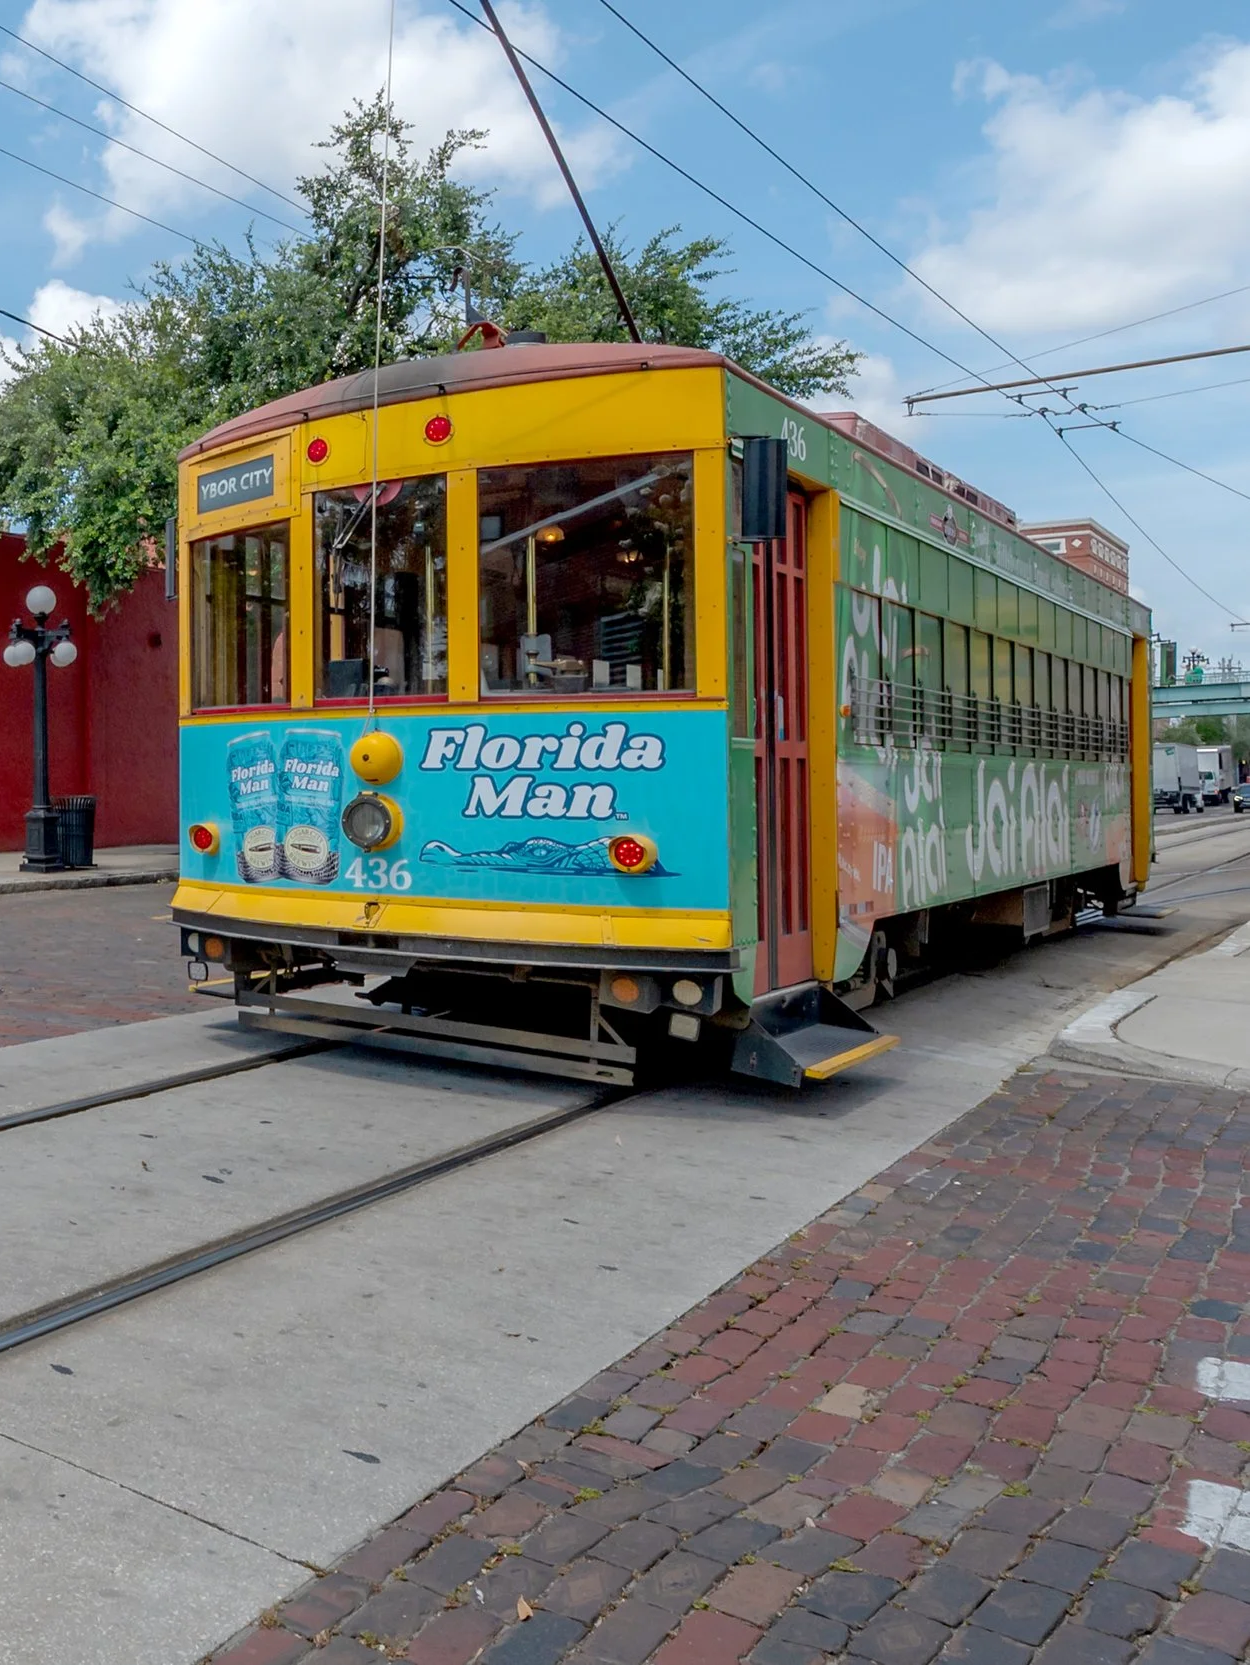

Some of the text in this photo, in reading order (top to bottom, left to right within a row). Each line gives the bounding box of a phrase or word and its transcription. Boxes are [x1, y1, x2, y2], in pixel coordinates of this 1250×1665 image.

[201, 466, 273, 500] YBOR CITY
[420, 721, 664, 771] Florida
[231, 758, 275, 783] Florida
[284, 757, 340, 778] Florida
[291, 775, 329, 793] Man
[239, 778, 269, 796] Man
[463, 775, 616, 820] Man
[965, 759, 1017, 881] Jai
[1020, 762, 1071, 876] Alai
[344, 857, 413, 891] 436
[872, 840, 894, 894] IPA
